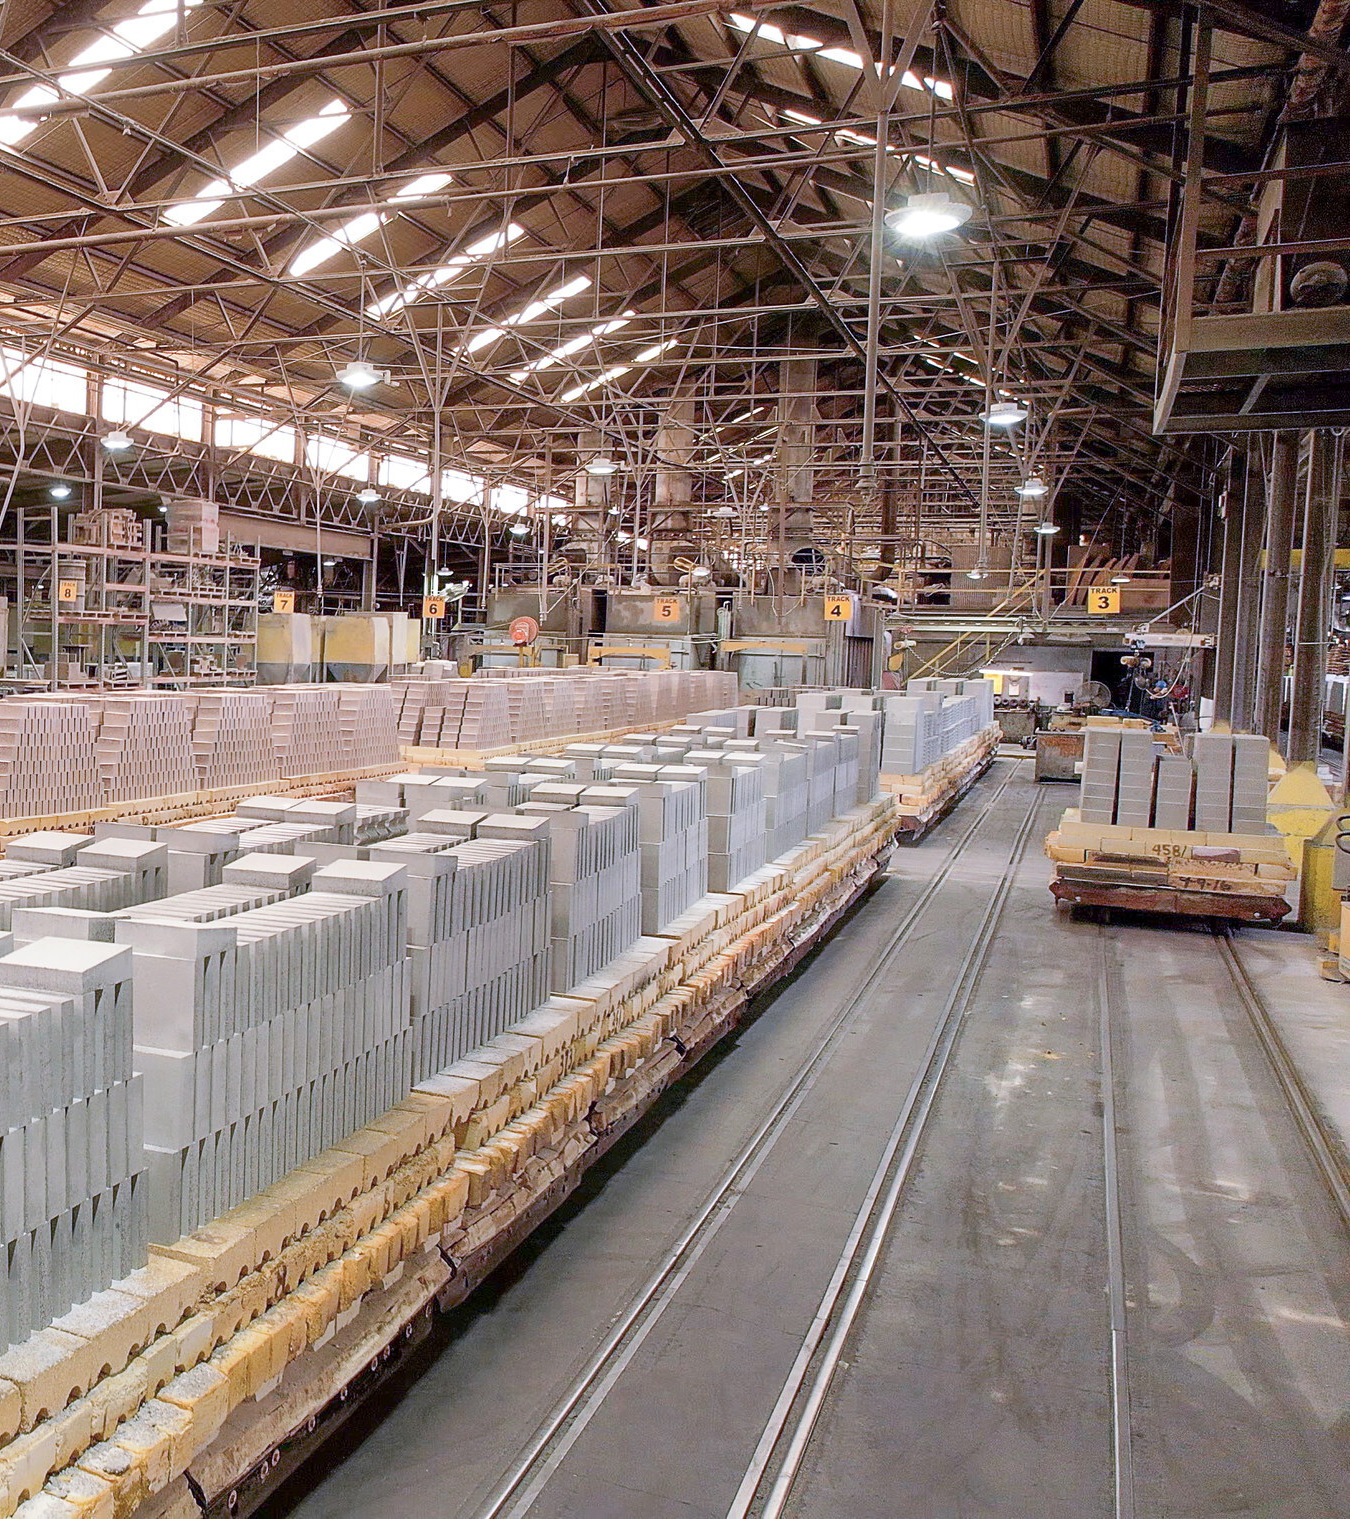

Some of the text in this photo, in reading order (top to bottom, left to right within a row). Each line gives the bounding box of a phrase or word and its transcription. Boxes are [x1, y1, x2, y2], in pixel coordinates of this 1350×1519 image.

[65, 589, 71, 599] 8
[280, 600, 288, 610] 7
[1098, 596, 1110, 609] 3
[429, 603, 438, 615] 6
[662, 605, 672, 617] 5
[831, 605, 842, 617] 4
